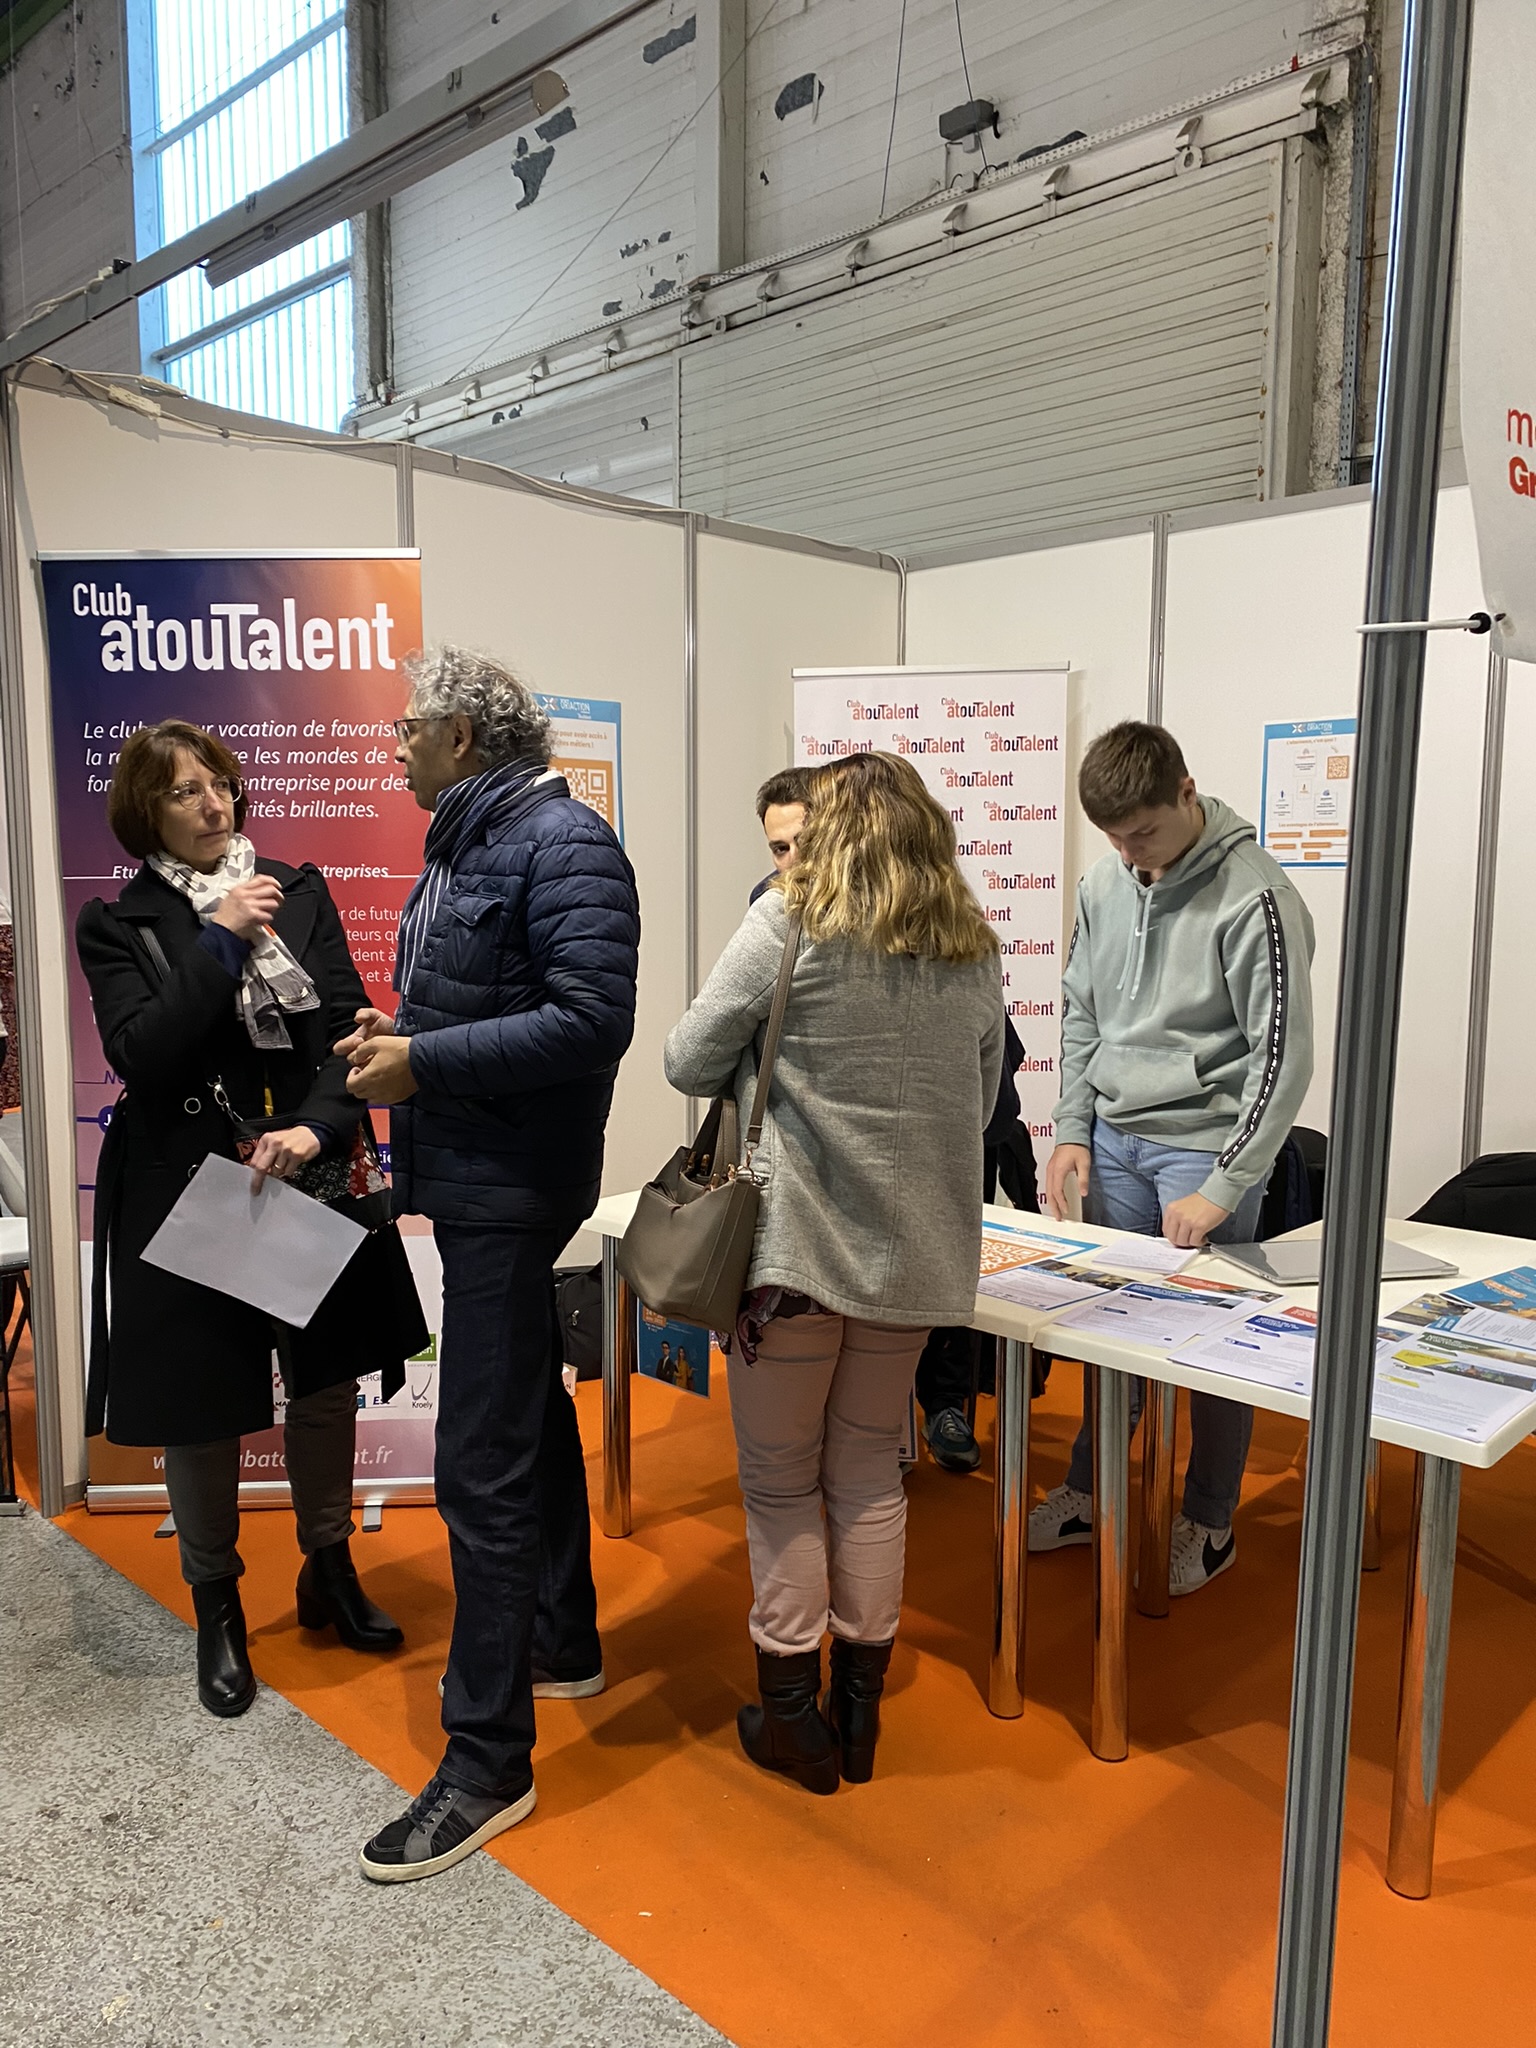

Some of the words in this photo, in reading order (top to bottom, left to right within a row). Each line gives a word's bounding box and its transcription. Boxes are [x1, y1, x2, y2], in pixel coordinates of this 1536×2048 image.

[72, 583, 132, 616] Club
[100, 597, 396, 672] atouTalent
[846, 700, 861, 708] Club
[941, 698, 955, 706] Club
[947, 700, 1015, 718] atouTalent
[853, 703, 919, 720] atouTalent
[83, 722, 104, 739] Le
[218, 720, 297, 737] vocation
[303, 719, 326, 737] de
[892, 733, 906, 742] Club
[984, 731, 999, 740] Club
[801, 735, 815, 743] Club
[807, 738, 873, 755] atouTalent
[898, 736, 965, 754] atouTalent
[990, 734, 1058, 752] atouTalent
[85, 748, 102, 766] la
[254, 747, 281, 765] les
[286, 746, 358, 765] mondes
[364, 746, 388, 764] de
[940, 767, 954, 776] Club
[946, 770, 1014, 788] atouTalent
[334, 777, 376, 796] pour
[289, 799, 379, 819] brillantes.
[983, 801, 997, 809] Club
[989, 804, 1057, 821] atouTalent
[957, 839, 1013, 856] ouTalent
[982, 869, 997, 878] Club
[988, 872, 1056, 890] atouTalent
[348, 906, 367, 921] de
[346, 928, 381, 941] teurs
[352, 947, 385, 962] dent
[1000, 938, 1055, 955] ouTalent
[366, 969, 381, 982] et
[1006, 1000, 1054, 1017] uTalent
